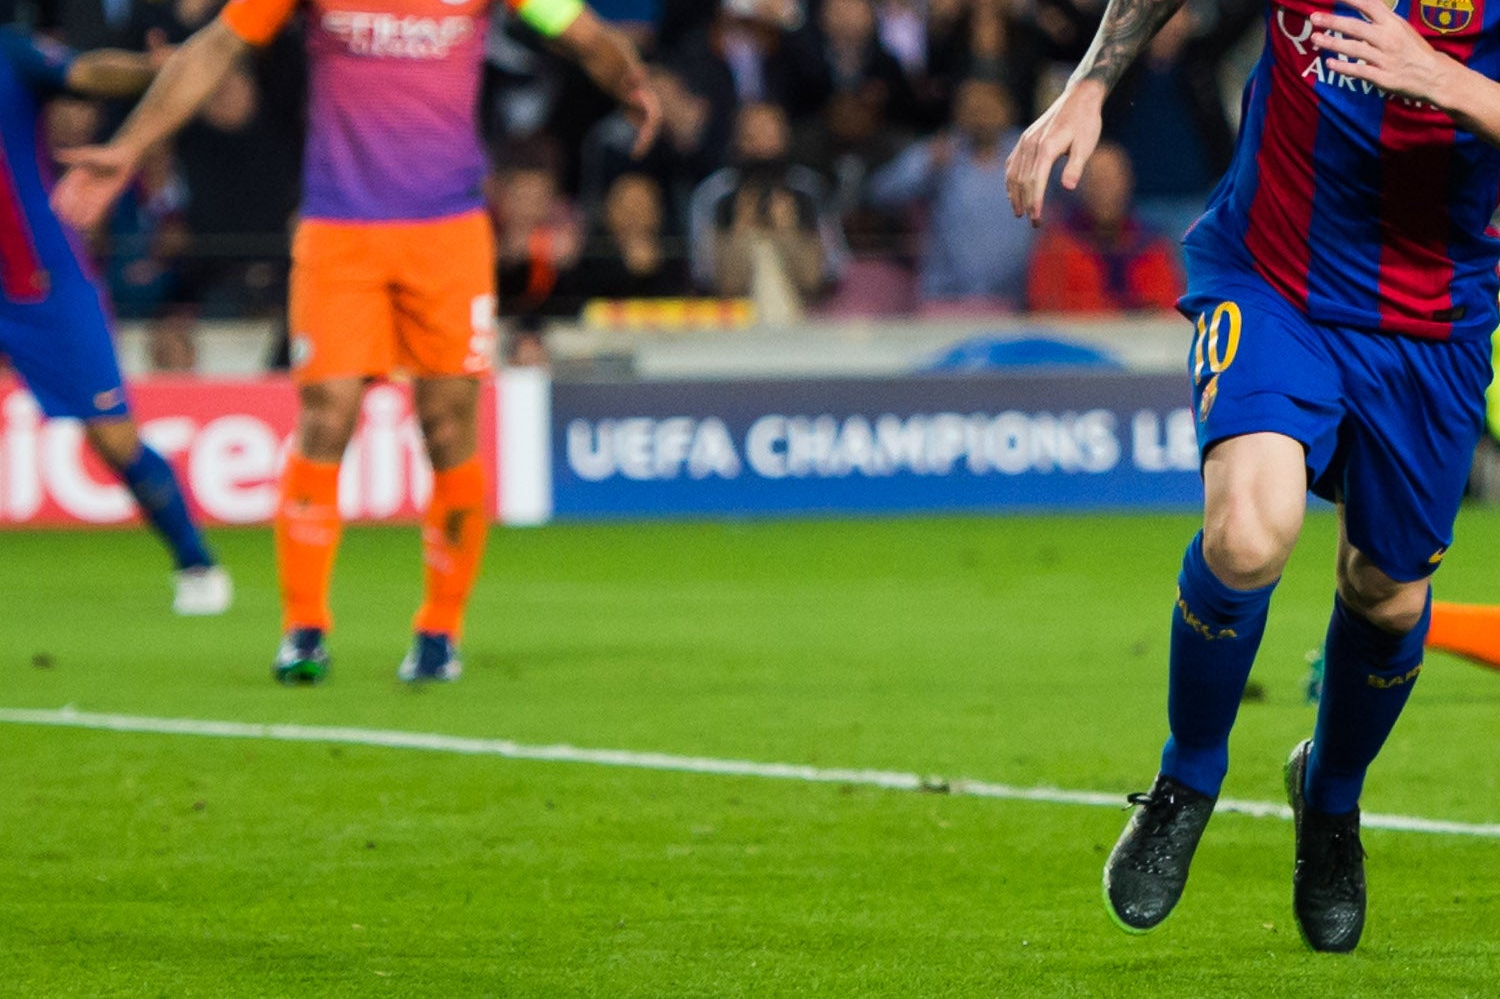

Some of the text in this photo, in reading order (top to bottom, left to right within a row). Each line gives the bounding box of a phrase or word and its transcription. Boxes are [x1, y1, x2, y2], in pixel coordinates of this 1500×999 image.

[1194, 300, 1242, 385] 10
[567, 415, 741, 480] UEFA
[745, 409, 1120, 479] CHAMPIONS
